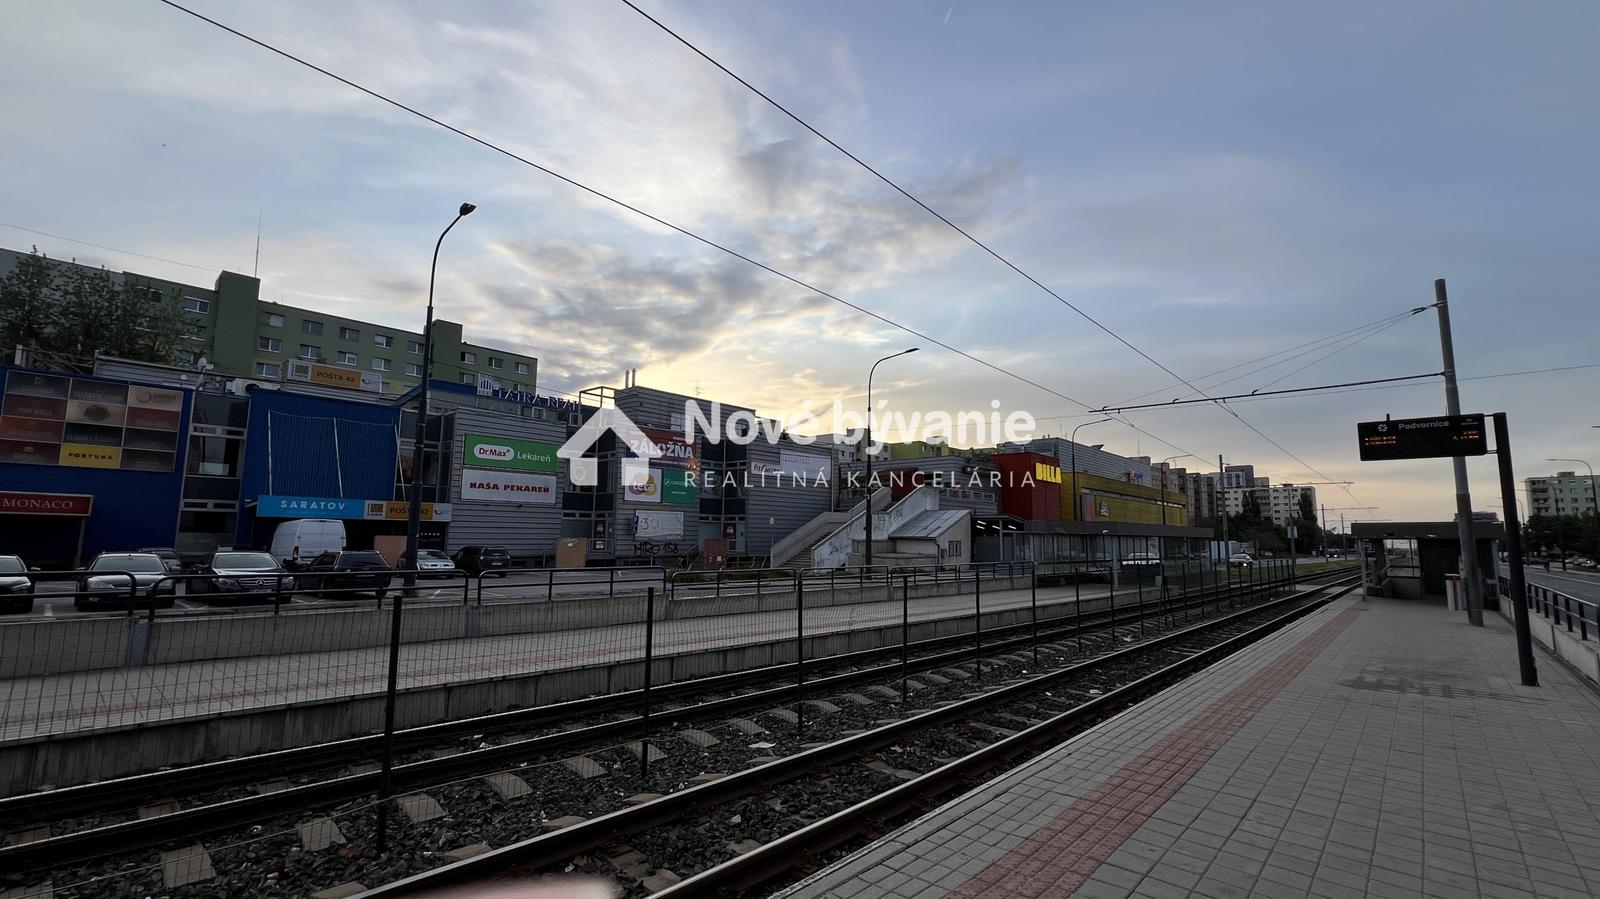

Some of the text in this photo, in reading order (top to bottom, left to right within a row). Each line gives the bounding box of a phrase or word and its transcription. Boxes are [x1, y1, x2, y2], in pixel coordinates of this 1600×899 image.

[68, 452, 113, 460] FORTUNA
[1035, 462, 1062, 484] BILLA
[2, 498, 73, 509] MONACO
[280, 500, 346, 510] SARATOV
